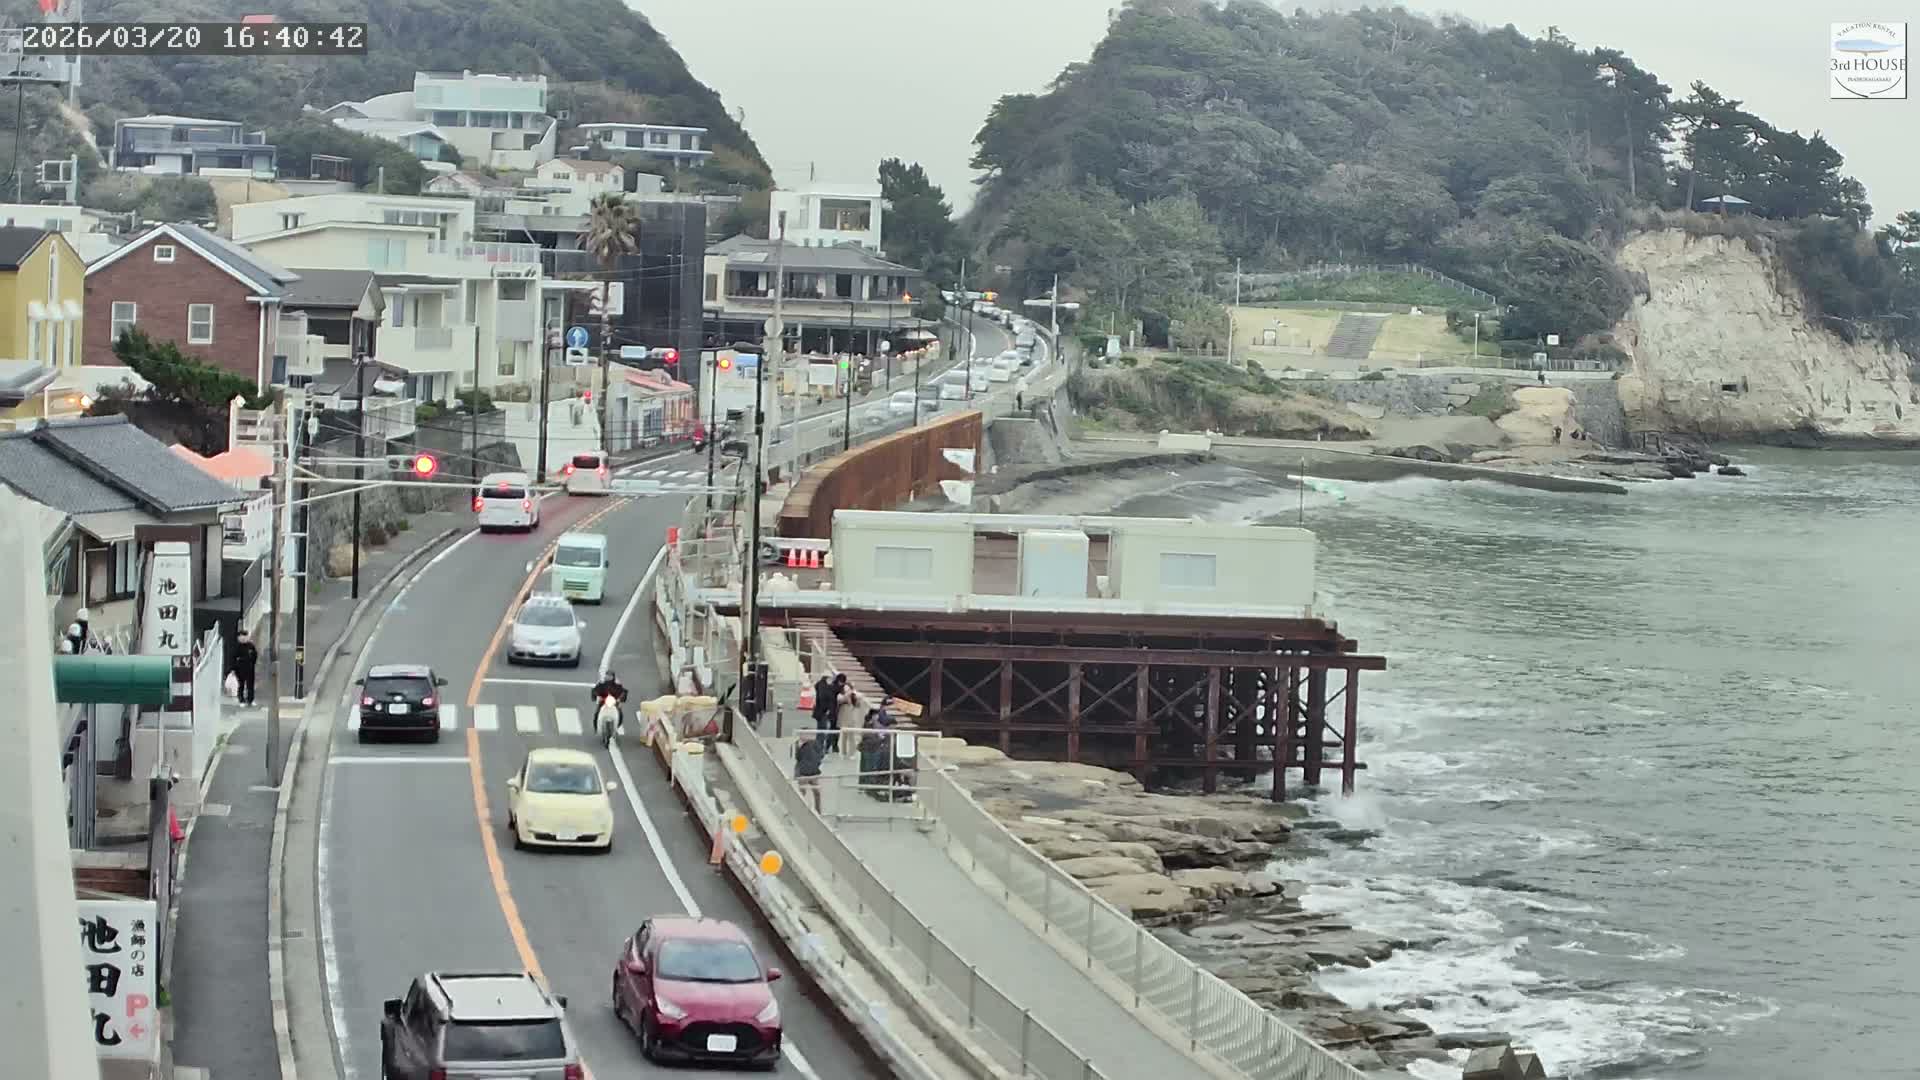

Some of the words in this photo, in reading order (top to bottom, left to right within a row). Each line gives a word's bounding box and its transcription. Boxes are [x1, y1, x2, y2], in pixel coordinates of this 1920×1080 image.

[158, 577, 179, 650] 池田丸
[130, 919, 146, 978] 漁師の店
[126, 994, 149, 1018] P
